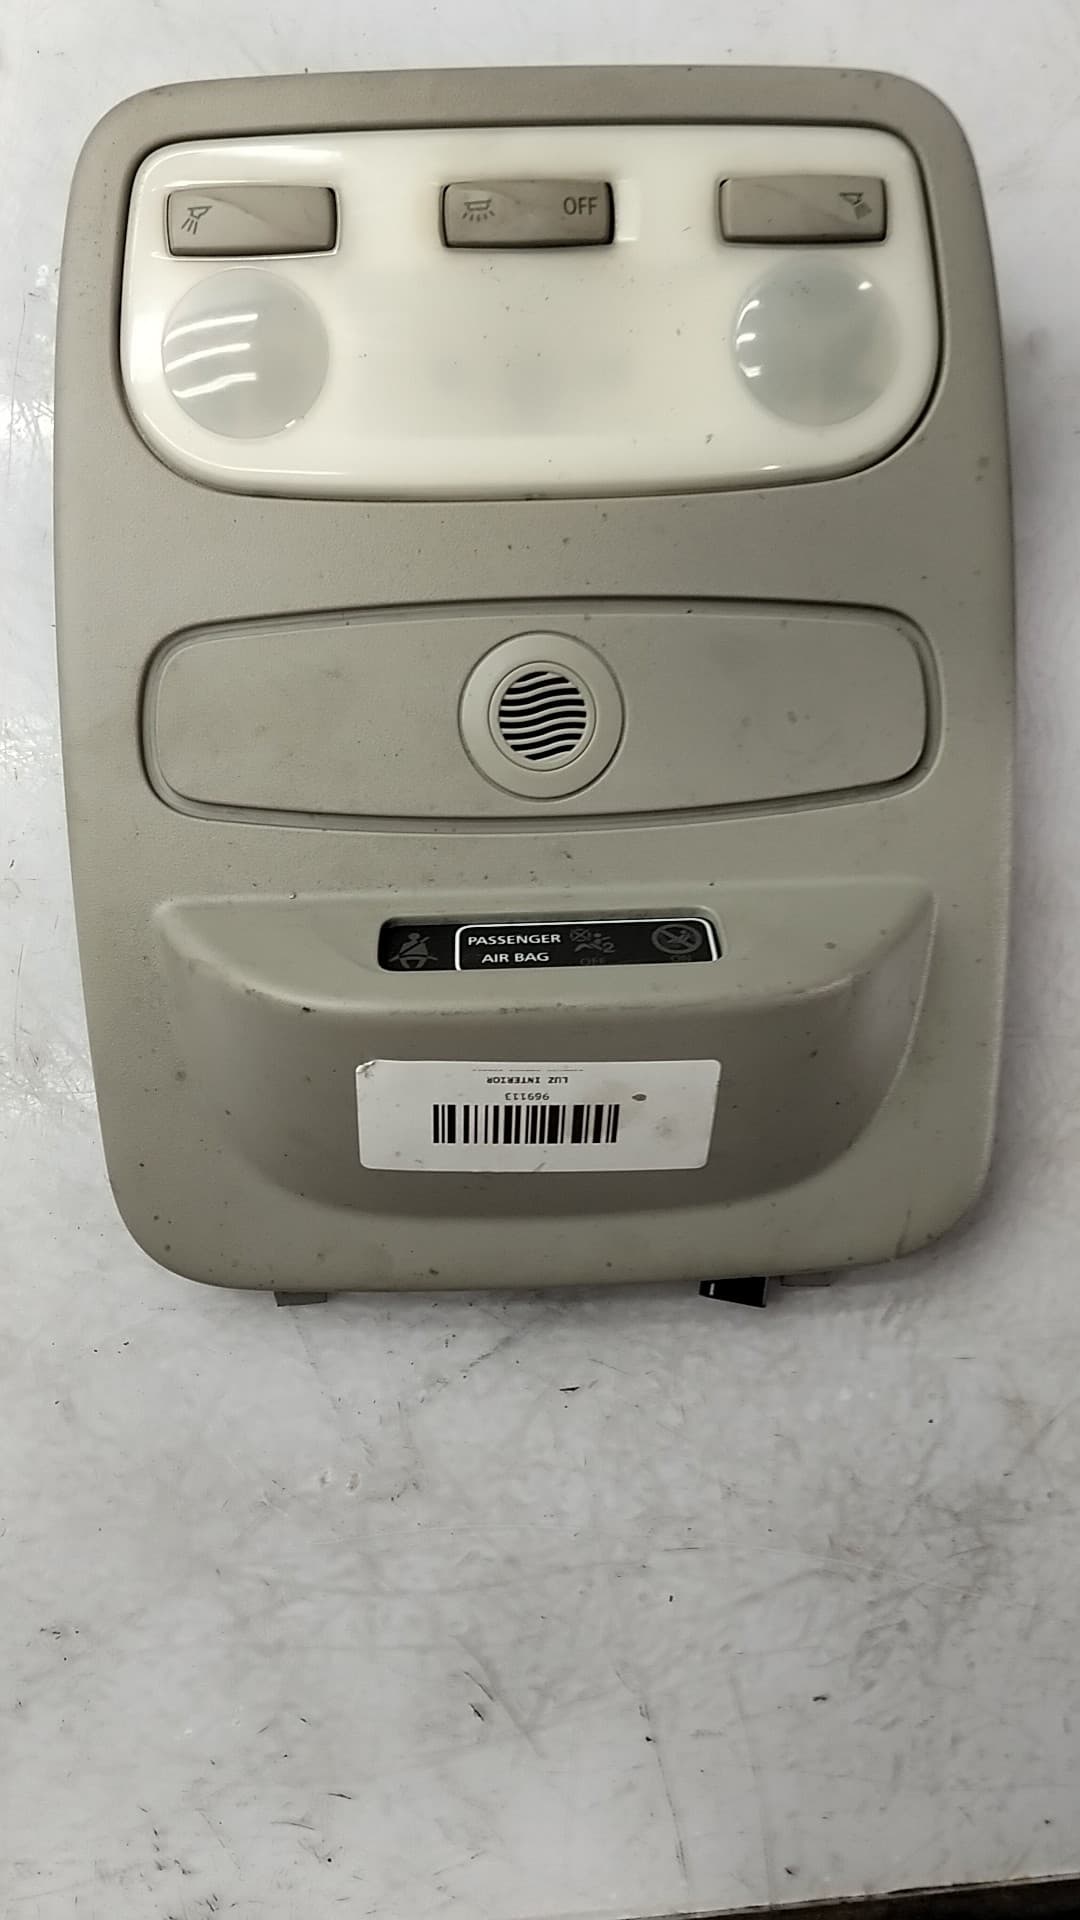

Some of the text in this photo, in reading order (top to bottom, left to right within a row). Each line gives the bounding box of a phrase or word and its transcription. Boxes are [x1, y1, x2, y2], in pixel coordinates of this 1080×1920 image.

[563, 196, 598, 216] OFF
[468, 933, 562, 946] PASSENGER
[481, 952, 550, 963] AIR BAG
[486, 1076, 569, 1084] LUZ INTERIOR
[504, 1092, 550, 1101] 969113
